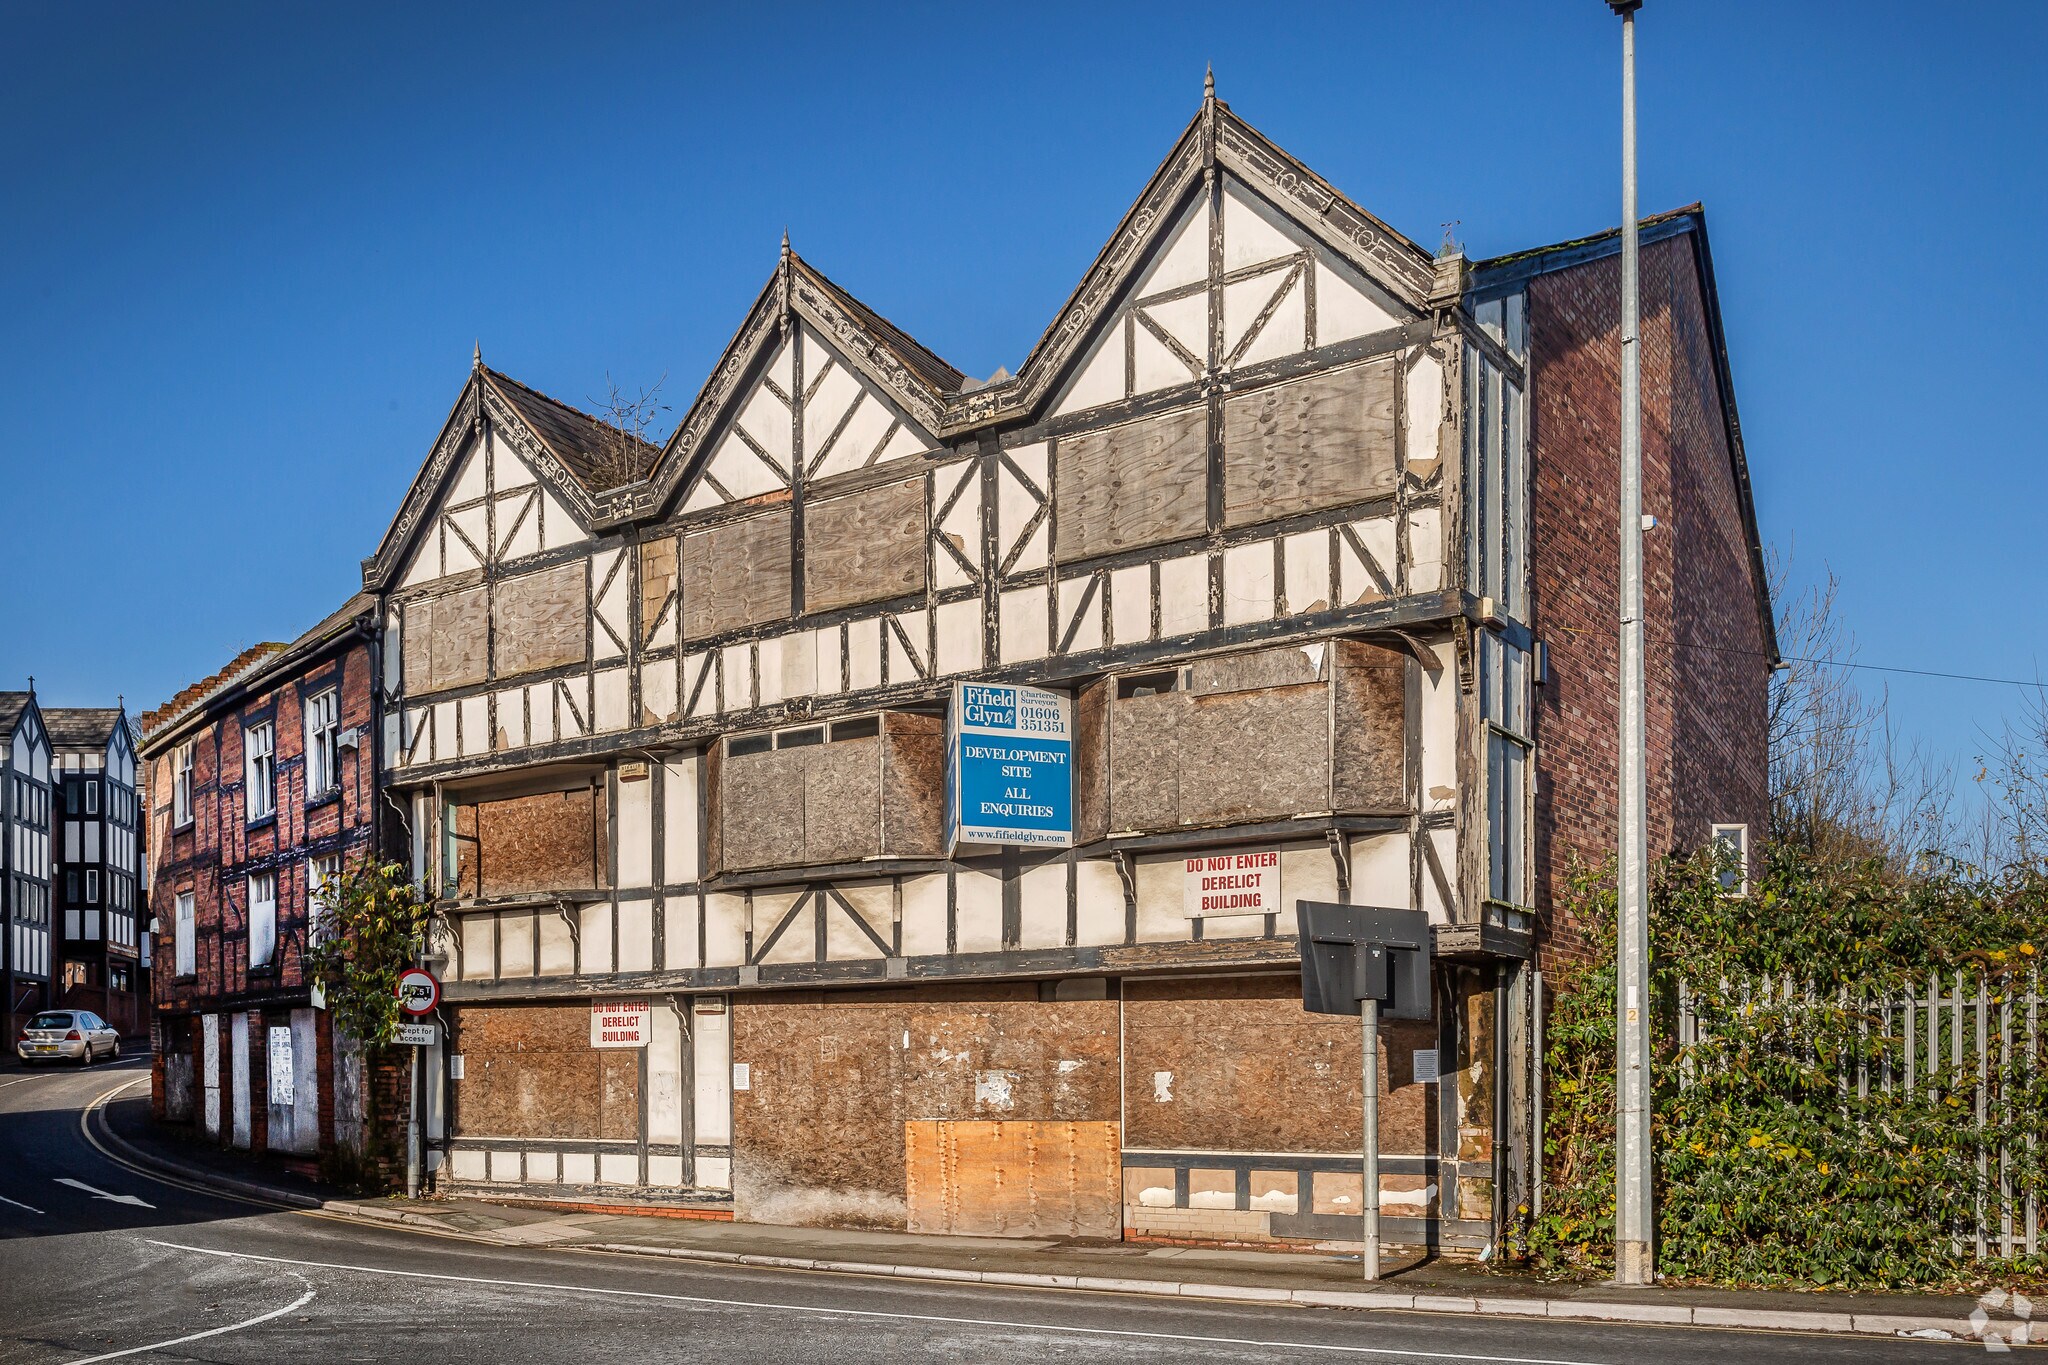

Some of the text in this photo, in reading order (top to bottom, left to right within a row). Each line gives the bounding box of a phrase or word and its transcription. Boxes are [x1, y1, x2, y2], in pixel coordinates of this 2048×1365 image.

[966, 687, 1015, 707] Fifield
[1020, 690, 1058, 700] Chartered
[1020, 697, 1058, 707] Surveyors
[965, 704, 1004, 726] Glyn
[1020, 706, 1060, 720] 01606
[1021, 719, 1066, 733] 351351
[965, 746, 1066, 764] DEVELOPMENT
[1001, 765, 1032, 778] SITE
[1004, 787, 1031, 799] ALL
[980, 802, 1053, 817] ENQUIRIES
[968, 830, 1066, 842] www.fifieldglyn.com
[1186, 852, 1277, 873] DO NOT ENTER
[1202, 873, 1261, 891] DERELICT
[1202, 893, 1261, 910] BUILDING
[593, 1001, 649, 1013] DO NOT ENTER
[602, 1016, 639, 1027] DERELICT
[1628, 1010, 1636, 1020] 2
[421, 1027, 432, 1035] for
[602, 1031, 639, 1042] BUILDING
